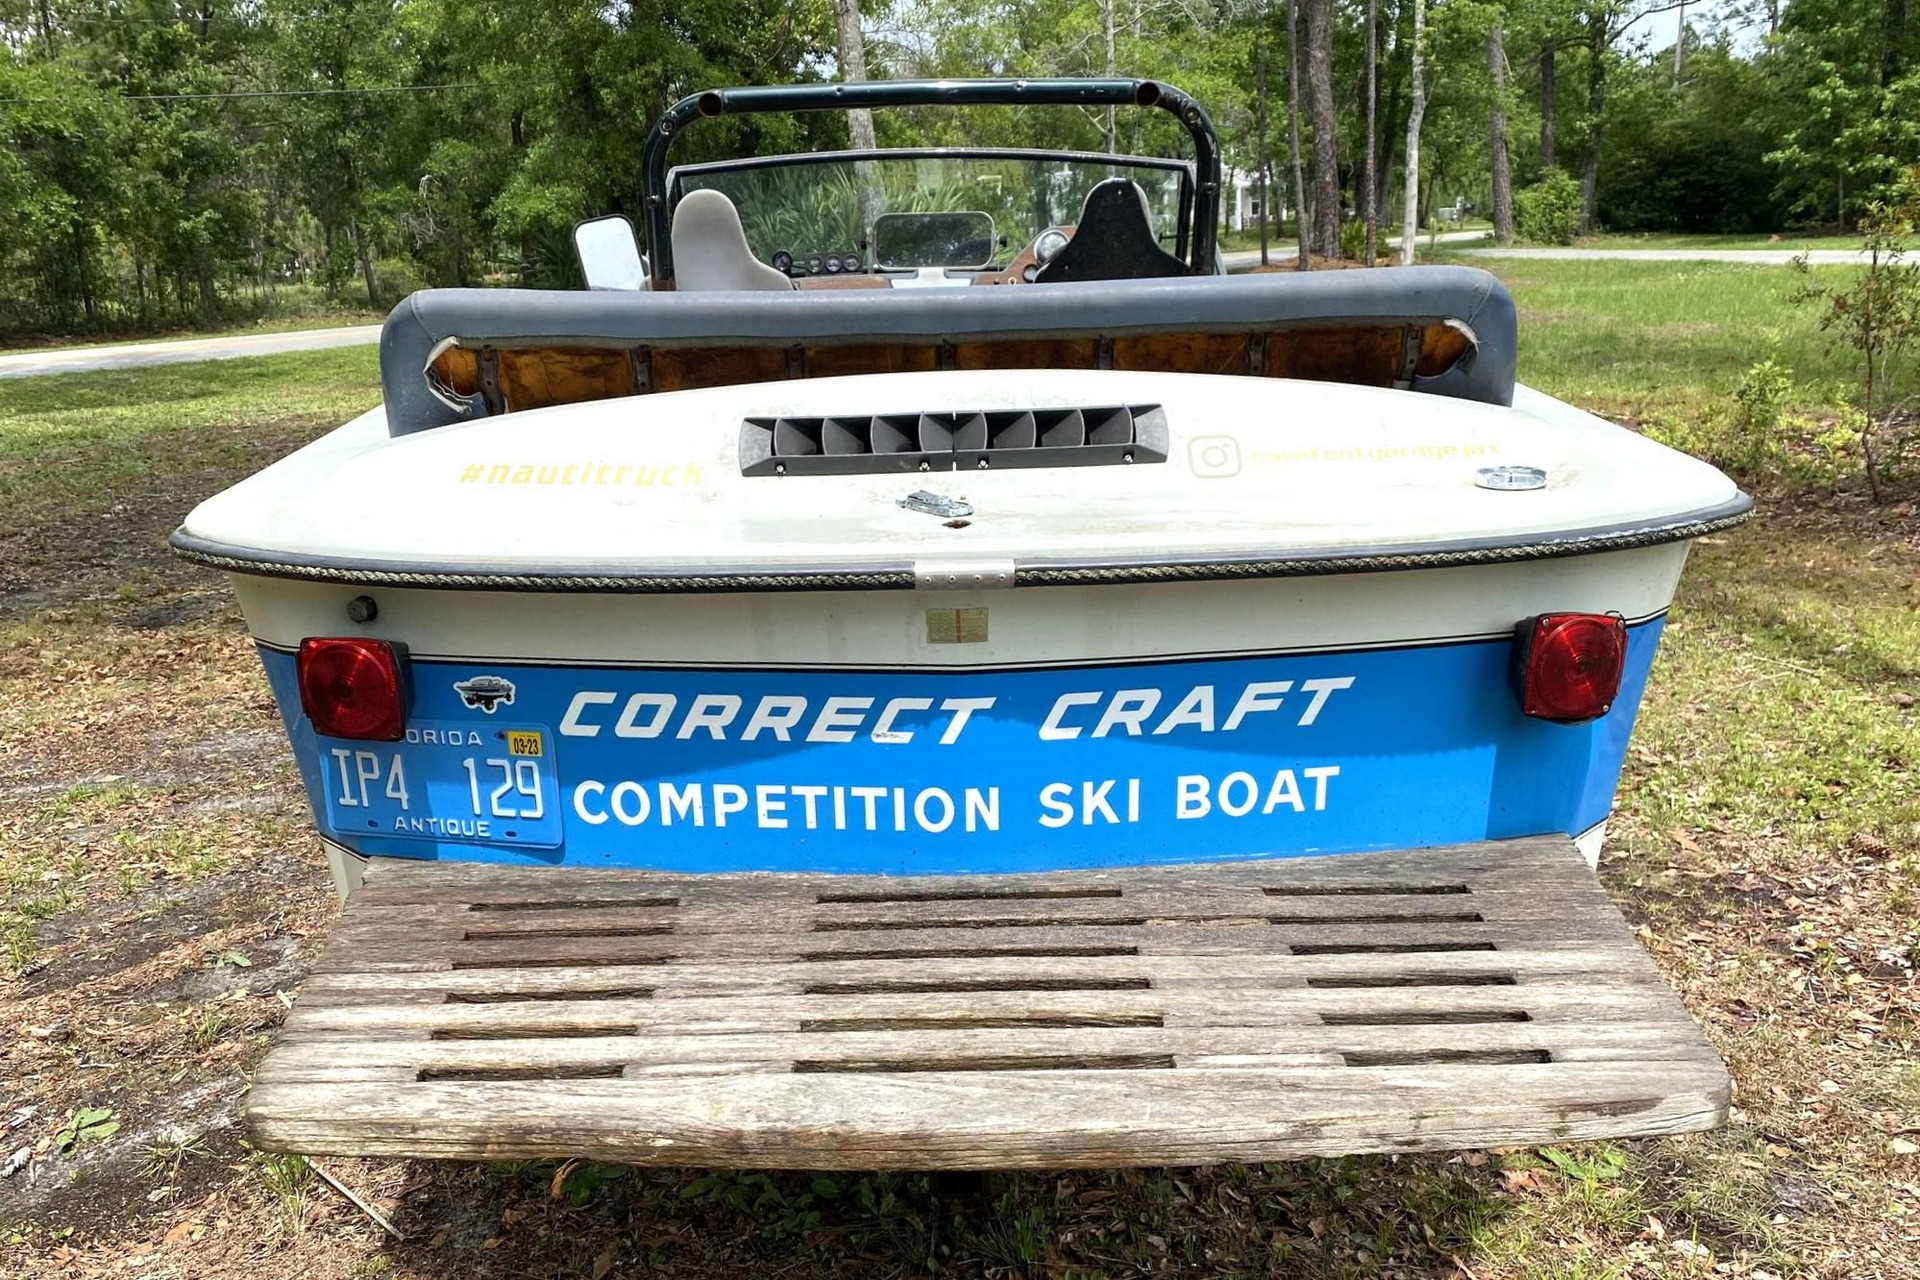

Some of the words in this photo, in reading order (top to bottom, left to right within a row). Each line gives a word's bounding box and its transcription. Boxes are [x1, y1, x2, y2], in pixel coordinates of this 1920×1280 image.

[459, 461, 704, 487] #nautitruck
[559, 691, 997, 745] CORRECT
[1039, 676, 1355, 741] CRAFT
[400, 728, 482, 746] ORIDA
[513, 737, 539, 755] 03-23
[331, 748, 409, 811] IP4
[462, 756, 544, 818] 129
[573, 780, 1000, 833] COMPETITION
[1039, 778, 1140, 828] SKI
[1176, 765, 1343, 819] BOAT
[393, 816, 493, 838] ANTIQUE
